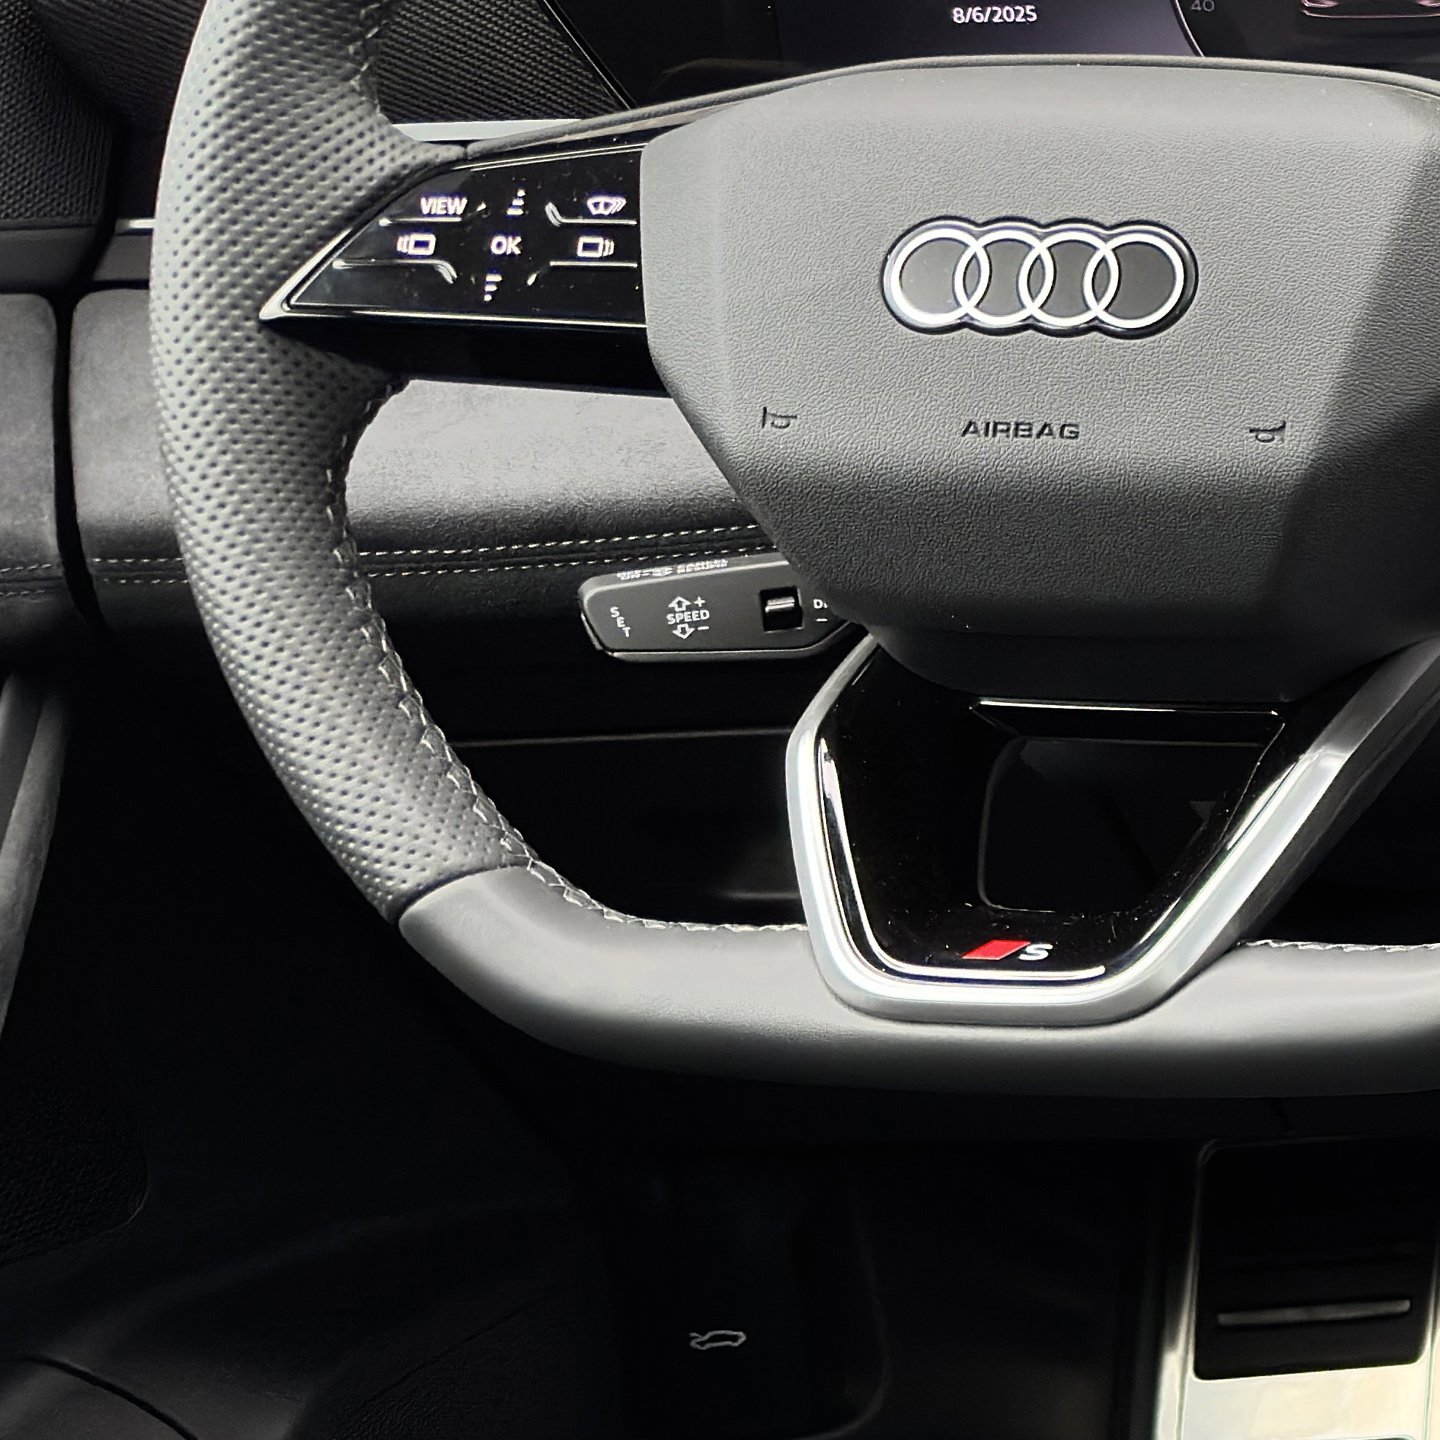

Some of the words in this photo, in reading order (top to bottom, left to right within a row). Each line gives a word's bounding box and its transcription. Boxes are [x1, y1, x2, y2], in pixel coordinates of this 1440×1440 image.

[953, 4, 1038, 24] 8/6/2025
[420, 196, 468, 215] VIEW
[490, 235, 522, 255] OK
[961, 420, 1080, 440] AIRBAG
[610, 606, 630, 638] SET
[666, 609, 711, 625] SPEED
